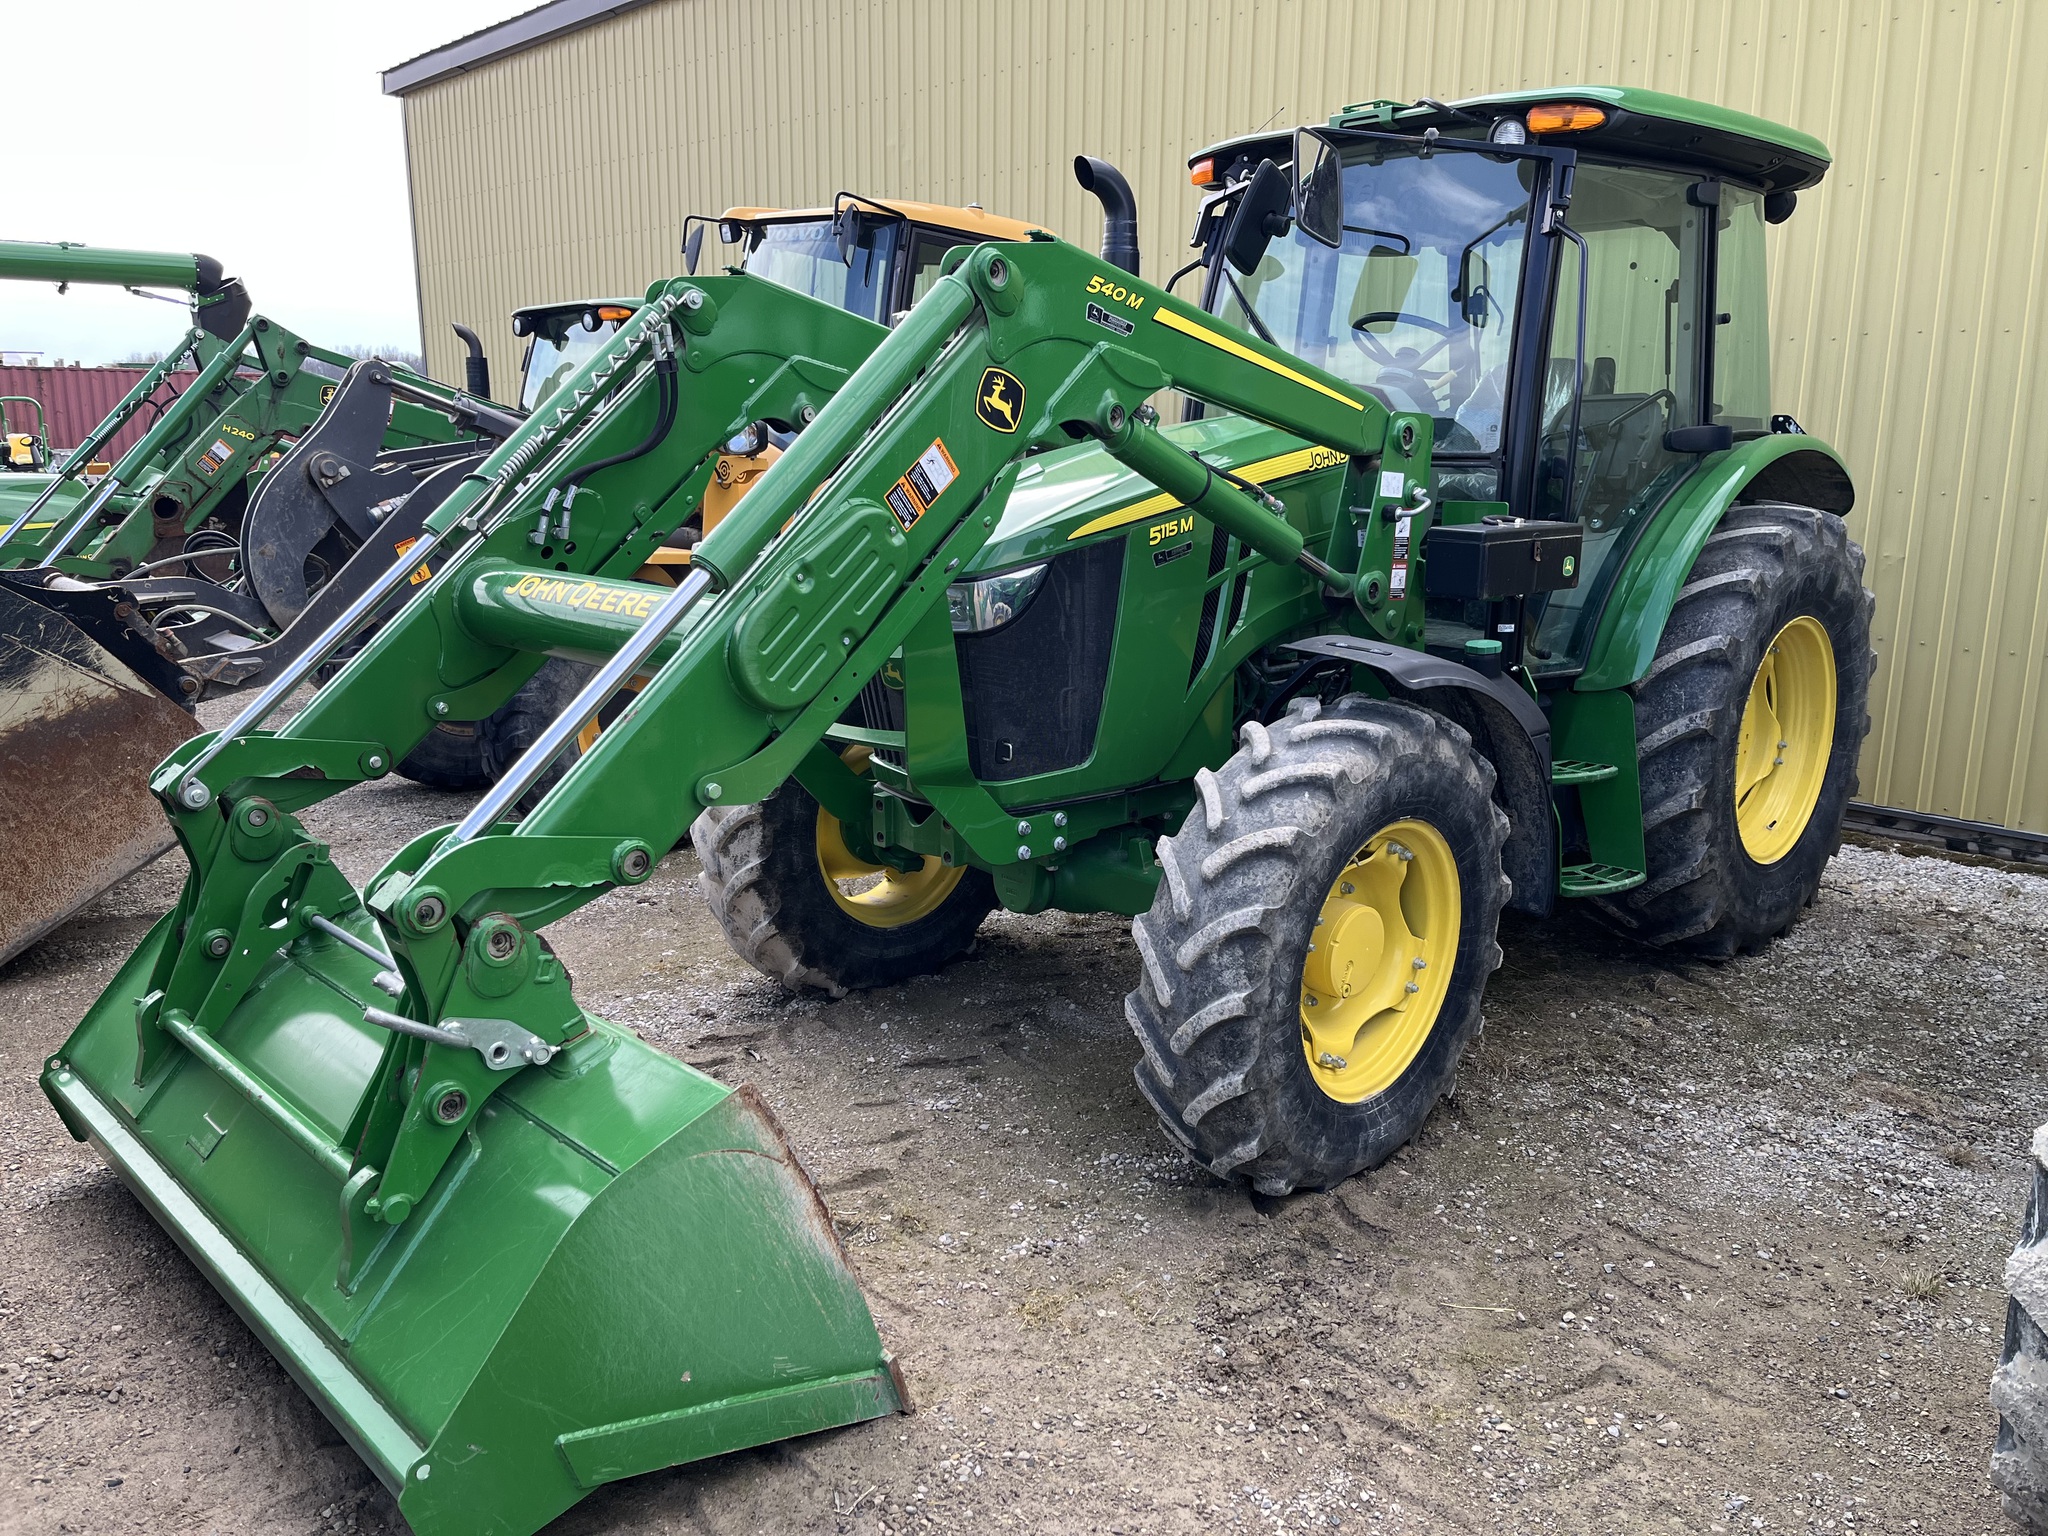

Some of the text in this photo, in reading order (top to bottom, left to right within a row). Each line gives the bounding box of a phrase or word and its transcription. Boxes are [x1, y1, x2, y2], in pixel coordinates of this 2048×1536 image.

[768, 226, 825, 241] VOLVO
[1085, 274, 1145, 311] 540 M
[222, 424, 255, 441] H240
[1309, 450, 1338, 469] JOHN
[1149, 515, 1194, 546] 5115 M
[505, 574, 661, 618] JOHN DEERE
